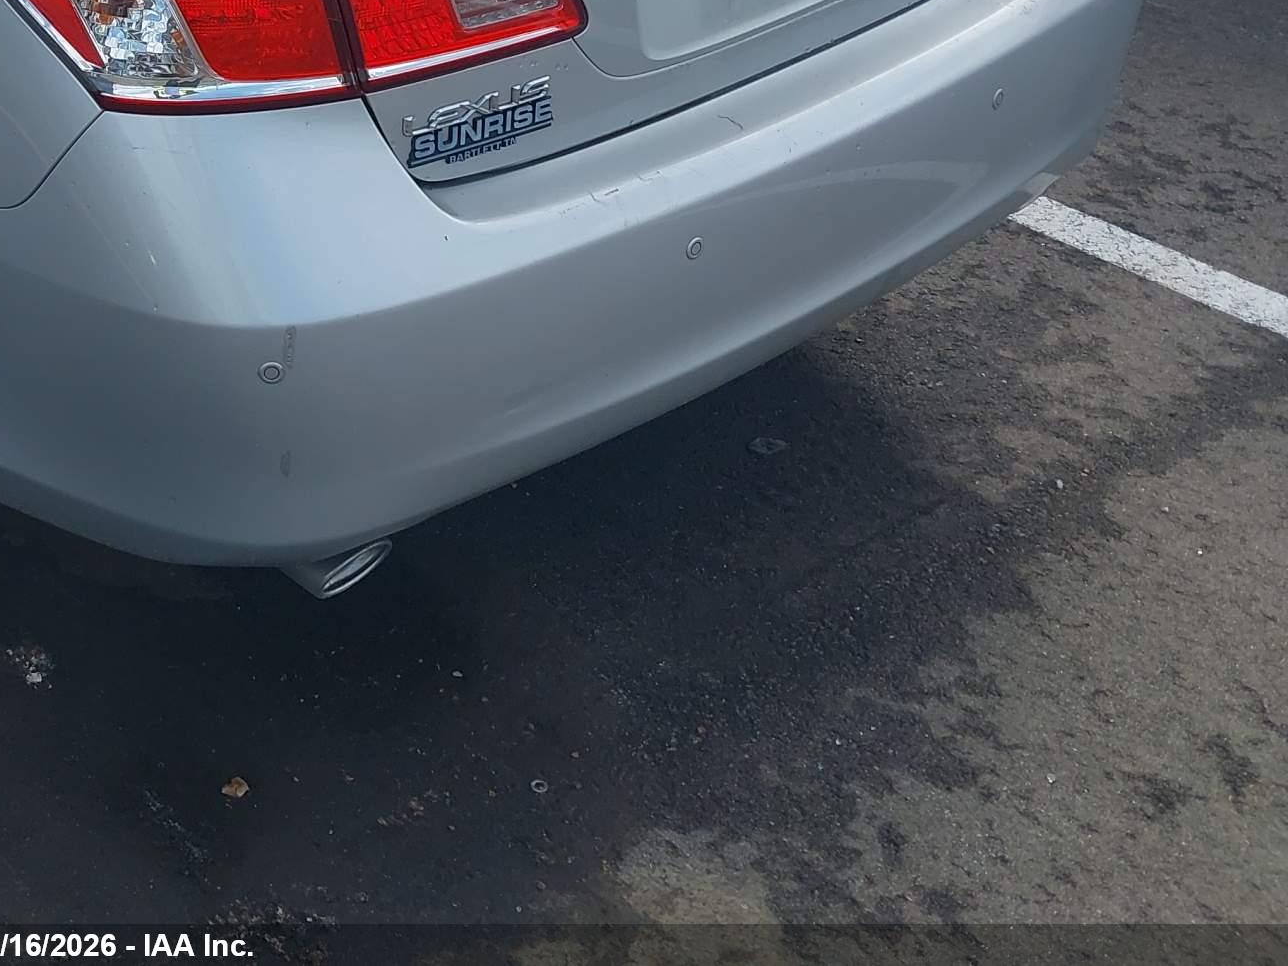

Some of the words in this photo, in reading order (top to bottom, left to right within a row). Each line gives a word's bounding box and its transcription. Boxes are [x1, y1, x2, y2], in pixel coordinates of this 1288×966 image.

[402, 75, 550, 137] LEXUS
[414, 98, 553, 159] SUNRISE
[449, 140, 502, 163] BARTLETT
